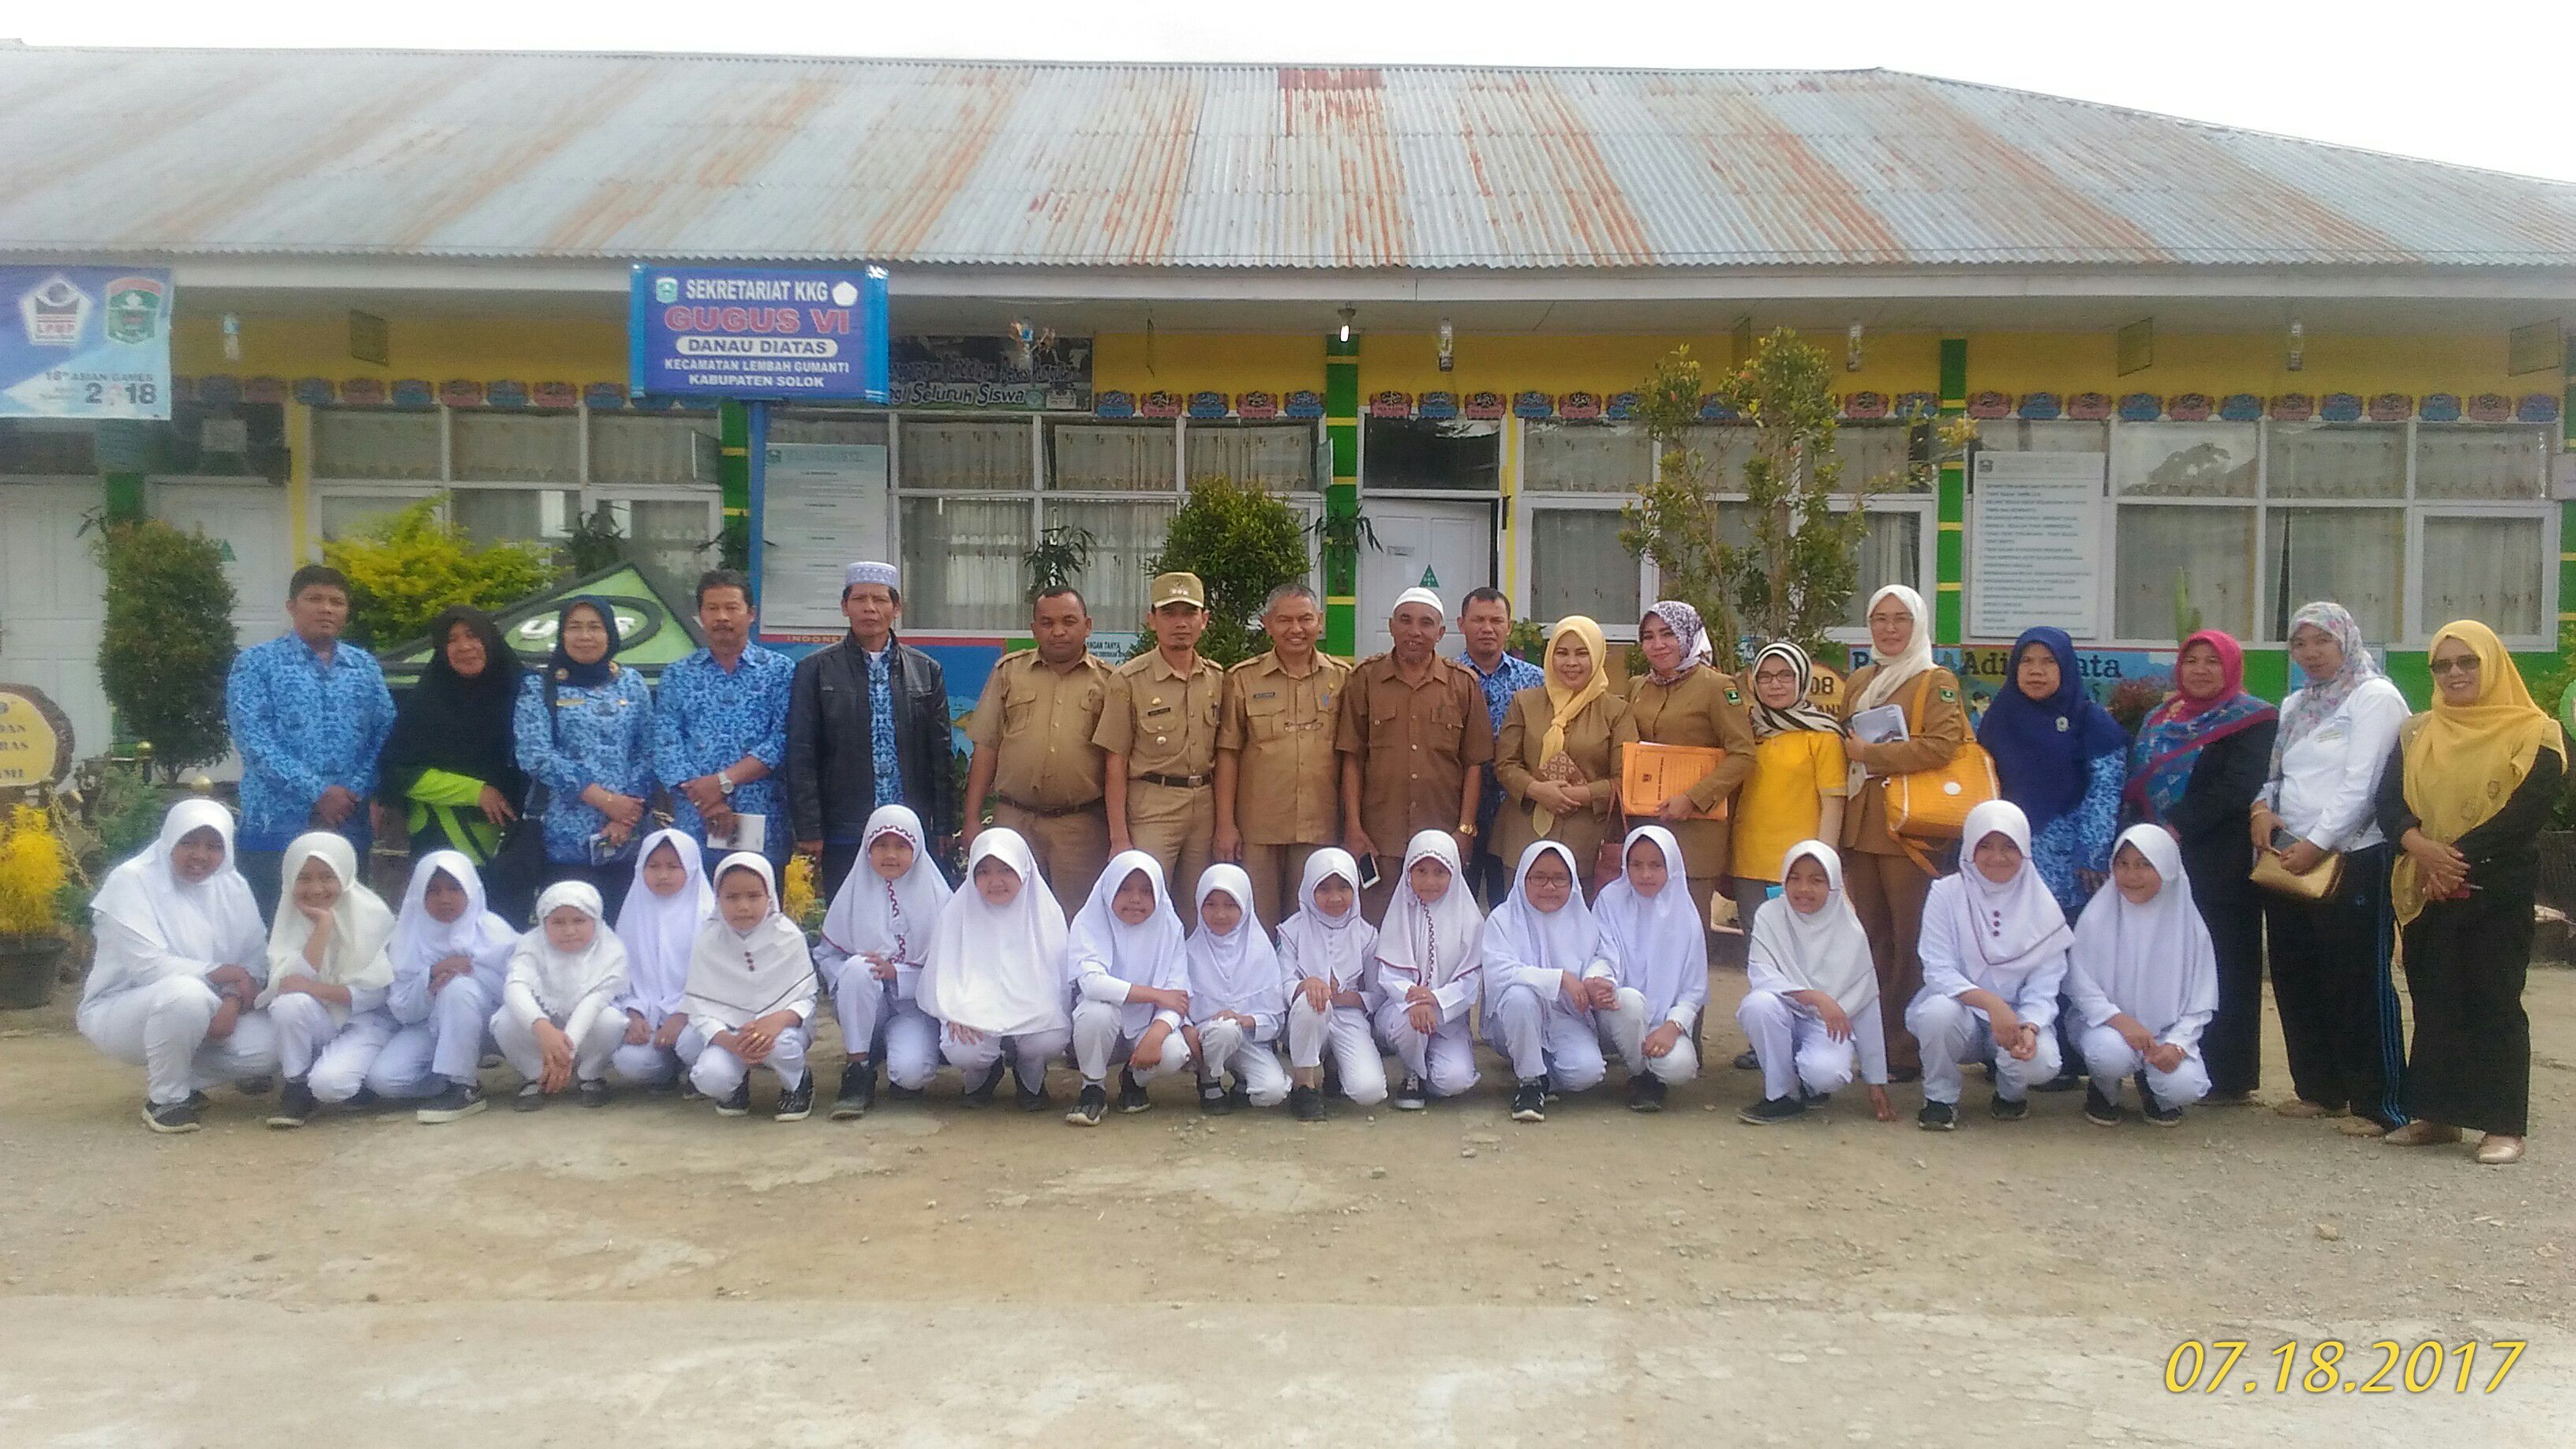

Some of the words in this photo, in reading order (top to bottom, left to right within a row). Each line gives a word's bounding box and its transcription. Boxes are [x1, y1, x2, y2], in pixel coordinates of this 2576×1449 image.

[685, 279, 790, 301] SEKRETARIAT
[794, 281, 828, 301] KKG
[664, 305, 801, 333] GUGUS
[809, 308, 850, 335] VI
[688, 338, 753, 353] DANAU
[760, 339, 827, 354] DIATAS
[665, 358, 739, 372] KECAMATAN
[743, 360, 792, 373] LEMBAH
[794, 361, 850, 373] GUMANTI
[70, 373, 107, 381] ASIAN
[112, 373, 153, 382] GAMES
[688, 374, 773, 387] KABUPATEN
[777, 376, 825, 388] SOLOK
[910, 381, 972, 404] Seluruh
[976, 383, 1024, 405] Siswa
